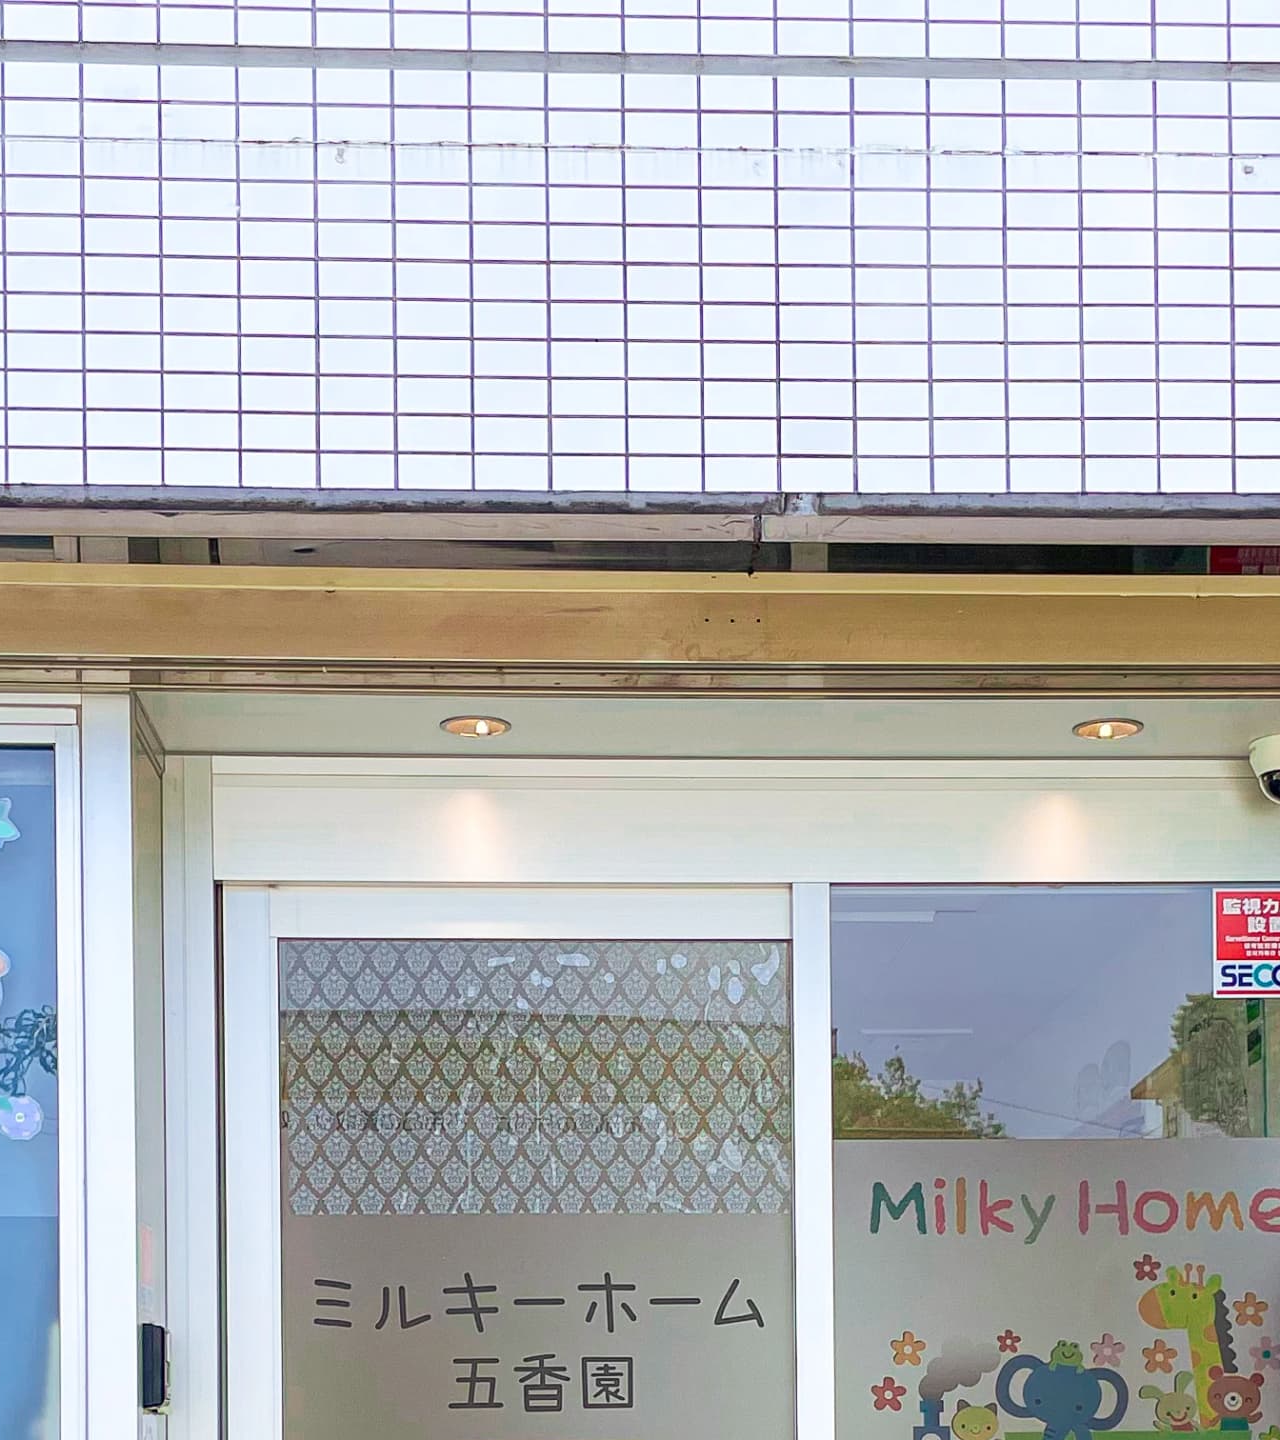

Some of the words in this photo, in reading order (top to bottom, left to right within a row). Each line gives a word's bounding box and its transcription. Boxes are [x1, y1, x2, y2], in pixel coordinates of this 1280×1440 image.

[869, 1177, 1056, 1245] Milky
[313, 1271, 768, 1334] ミルキーホーム
[447, 1353, 636, 1413] 五香園
